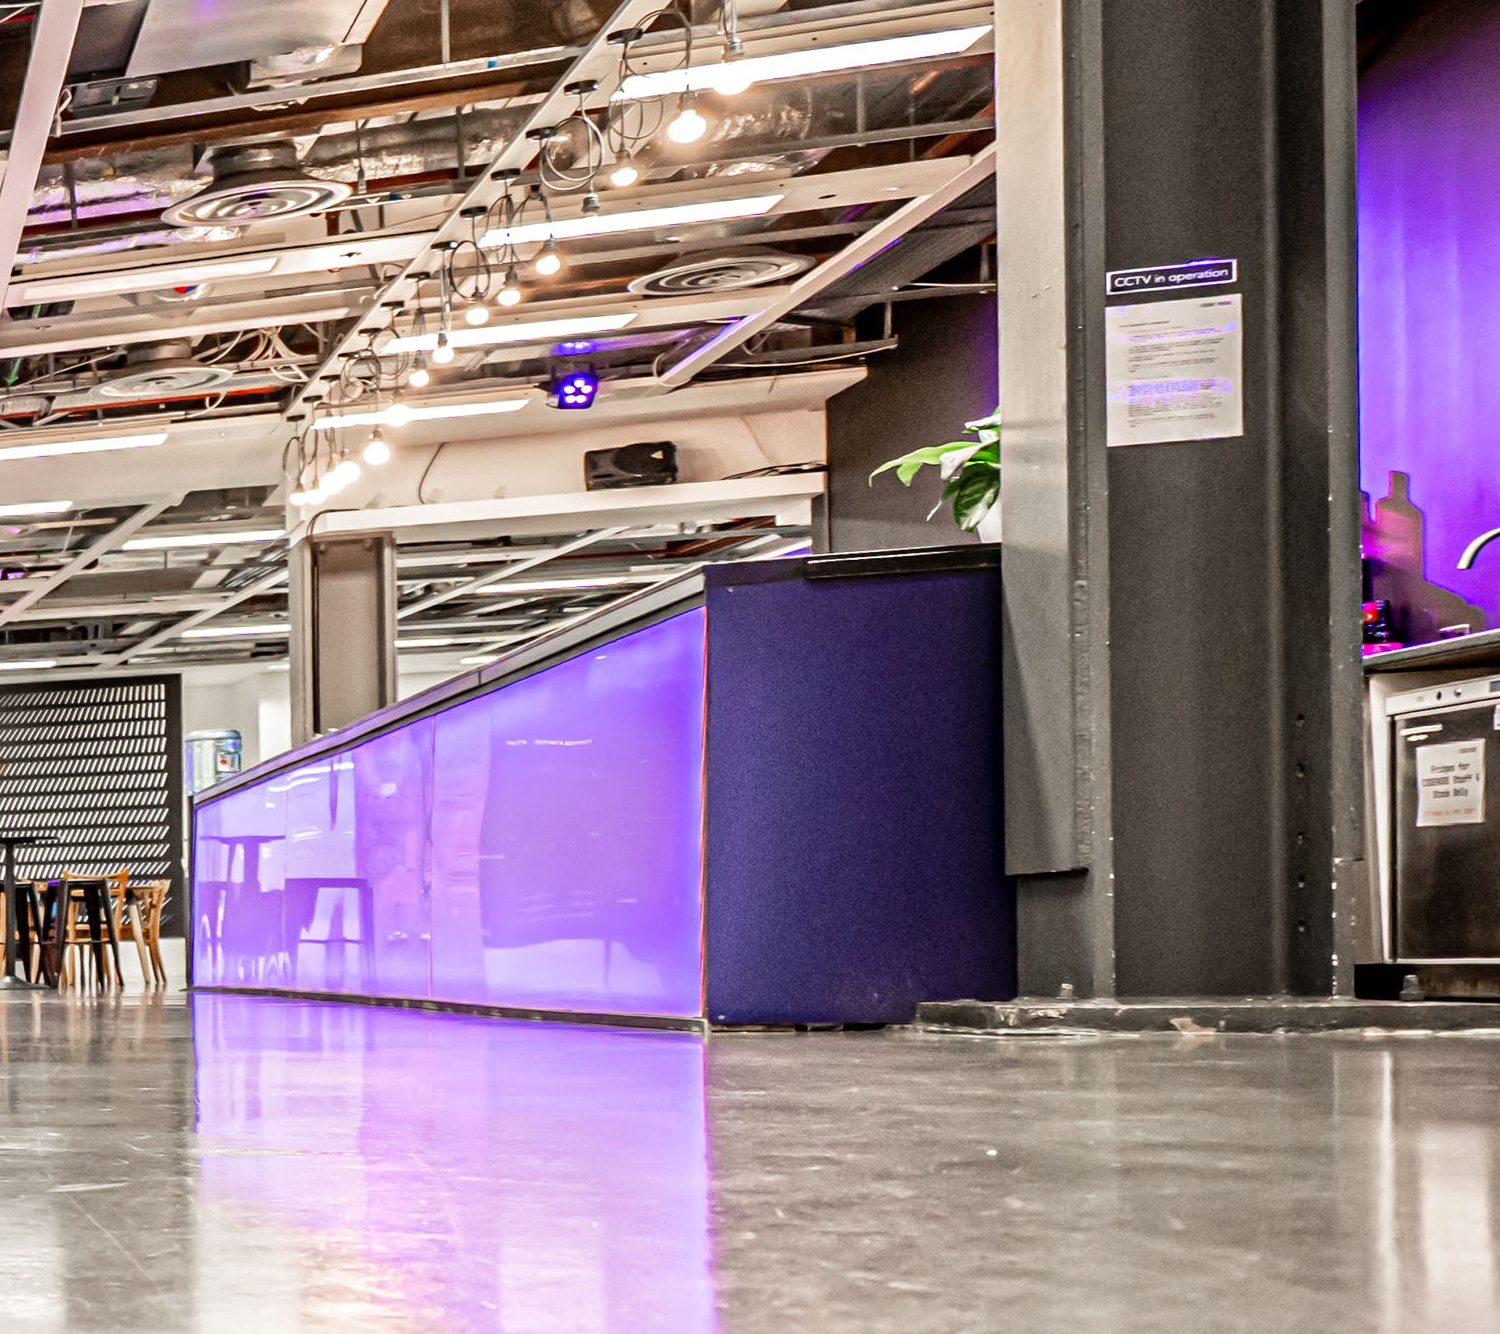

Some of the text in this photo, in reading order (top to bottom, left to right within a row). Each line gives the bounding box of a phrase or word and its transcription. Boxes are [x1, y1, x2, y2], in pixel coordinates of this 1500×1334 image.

[1114, 268, 1228, 287] CCTV in operation
